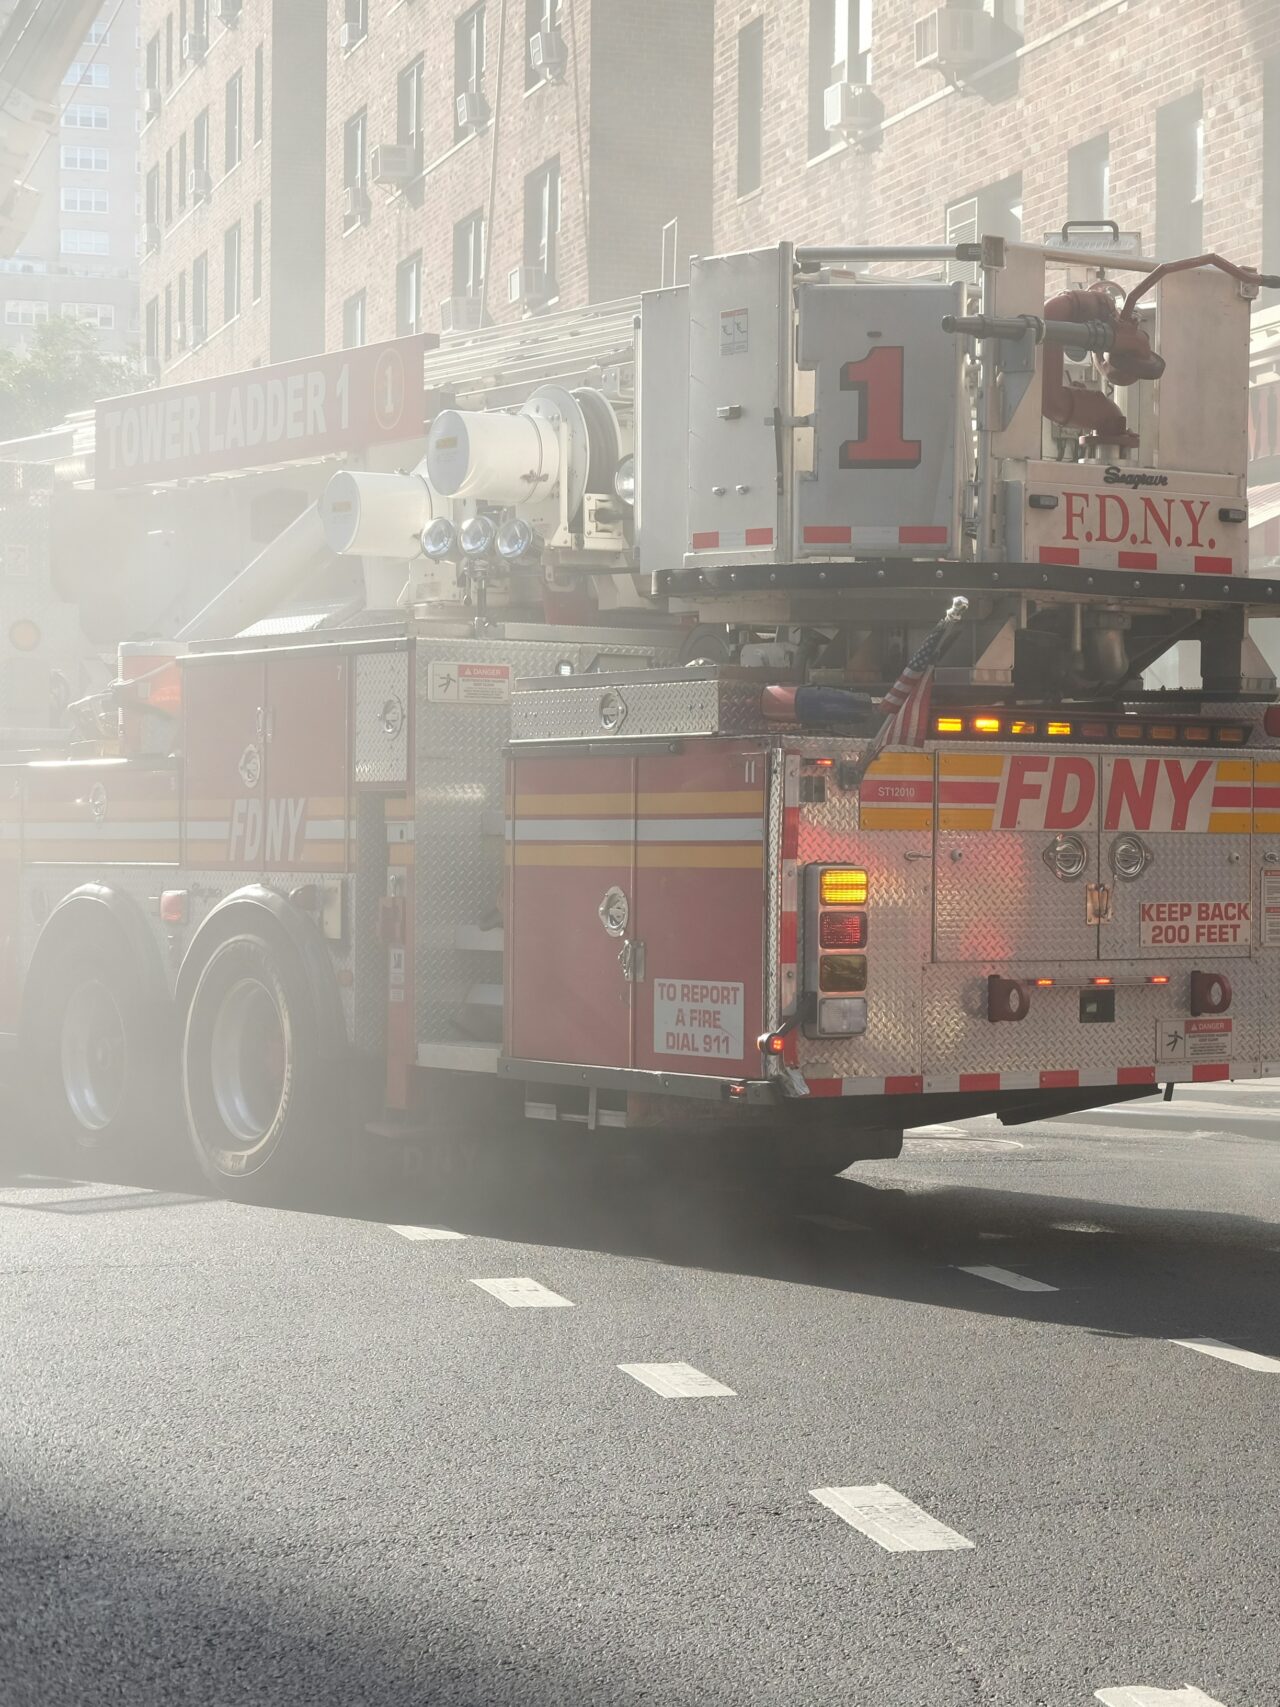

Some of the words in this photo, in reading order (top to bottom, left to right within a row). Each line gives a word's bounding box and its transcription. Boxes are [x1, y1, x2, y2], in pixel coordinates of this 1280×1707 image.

[104, 395, 202, 471] TOWER
[208, 371, 328, 453] LADDER
[336, 363, 350, 430] 1
[839, 346, 922, 469] 1
[1103, 466, 1169, 490] Seagrave
[1061, 491, 1217, 550] F.D.N.Y.
[472, 667, 502, 677] DANGER
[877, 786, 916, 799] ST12010
[999, 755, 1214, 831] FDNY
[228, 797, 306, 862] FDNY
[1141, 903, 1193, 922] KEEP
[1196, 902, 1251, 922] BACK
[1151, 925, 1190, 944] 200
[1195, 924, 1241, 943] FEET
[657, 983, 677, 1002] TO
[681, 984, 740, 1005] REPORT
[675, 1008, 686, 1027] A
[689, 1009, 721, 1029] FIRE
[1198, 1022, 1225, 1031] DANGER
[665, 1032, 699, 1052] DIAL
[702, 1034, 730, 1055] 911
